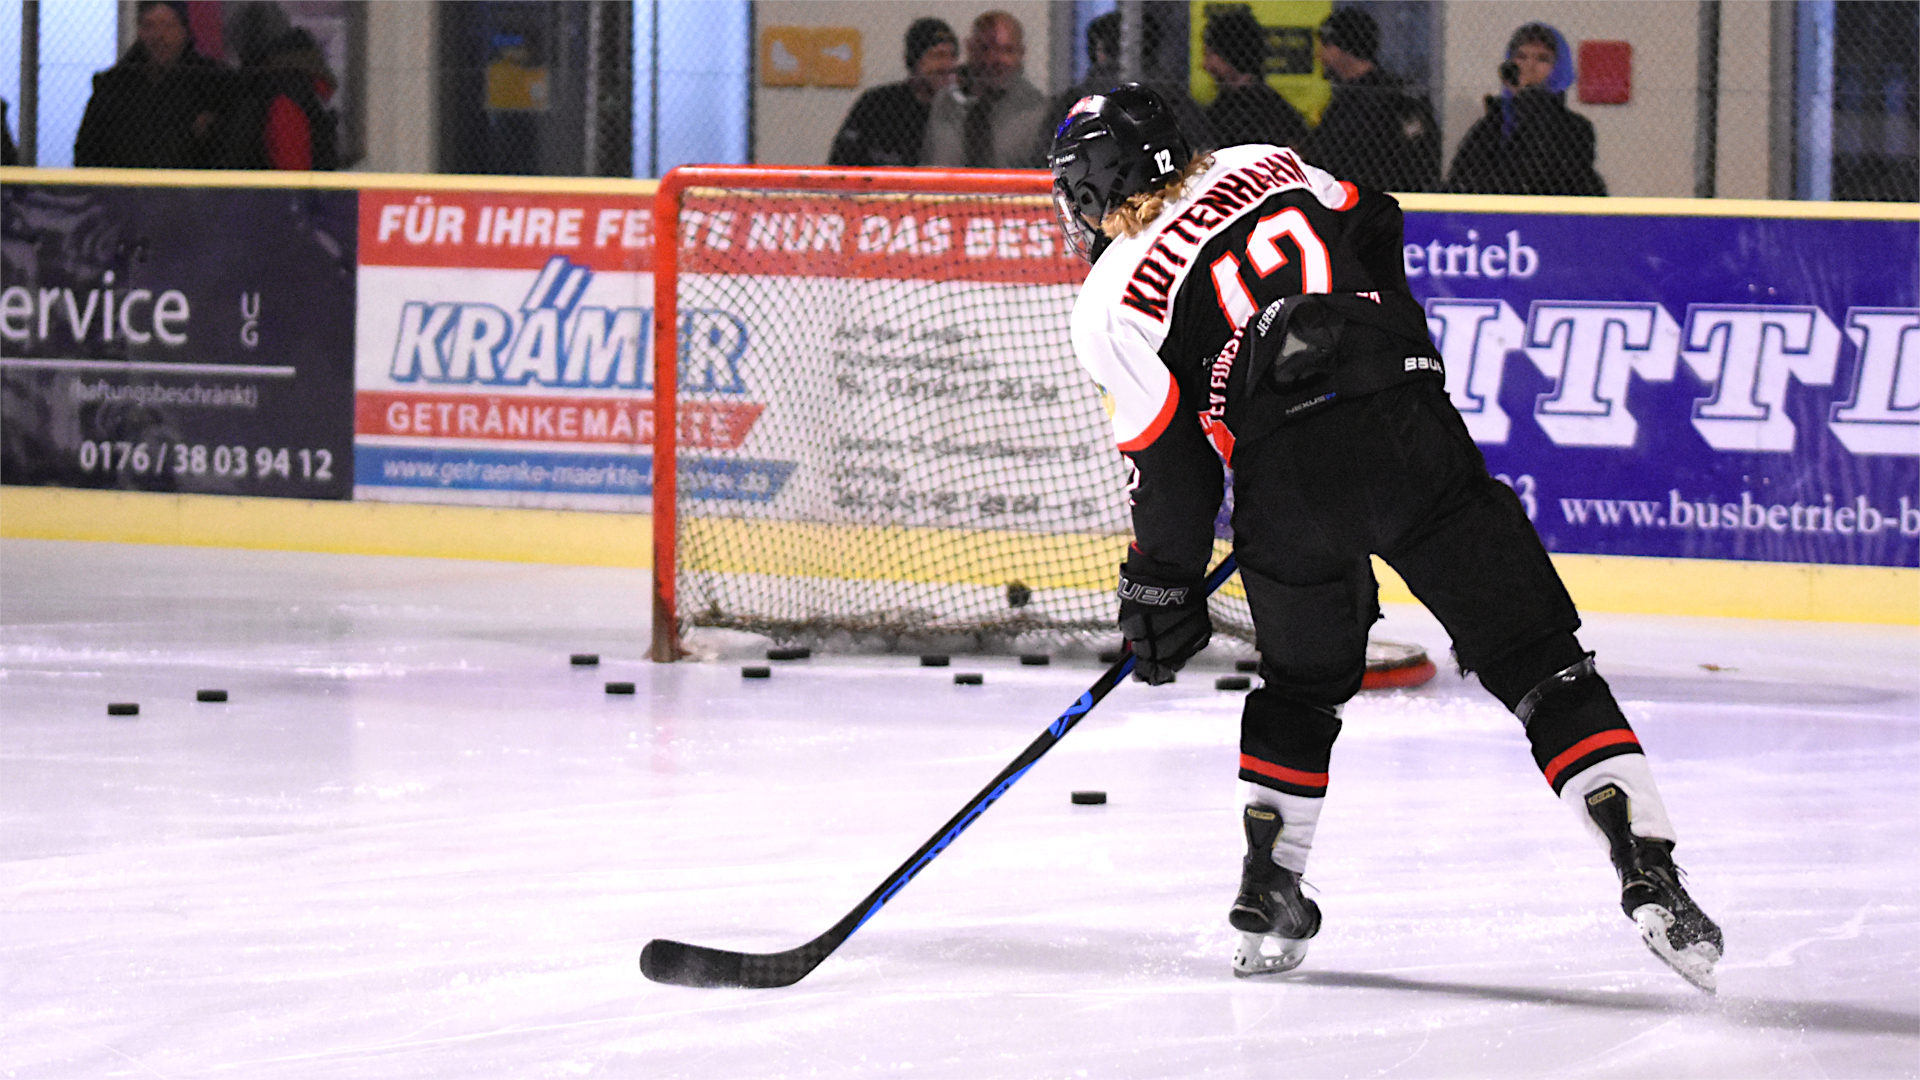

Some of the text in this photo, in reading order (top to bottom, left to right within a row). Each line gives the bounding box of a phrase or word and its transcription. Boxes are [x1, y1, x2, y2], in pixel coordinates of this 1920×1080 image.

[1154, 148, 1175, 175] 12
[378, 196, 1084, 259] FÜR IHRE FETE NUR DAS BEST
[1403, 230, 1538, 278] etrieb
[0, 270, 190, 344] ervice
[1404, 356, 1444, 374] BAU
[386, 399, 731, 441] GETRÄNKEMÄRTE
[79, 440, 333, 480] 0176 / 38 03 94 12
[1495, 473, 1537, 523] 3
[1117, 577, 1189, 606] UER
